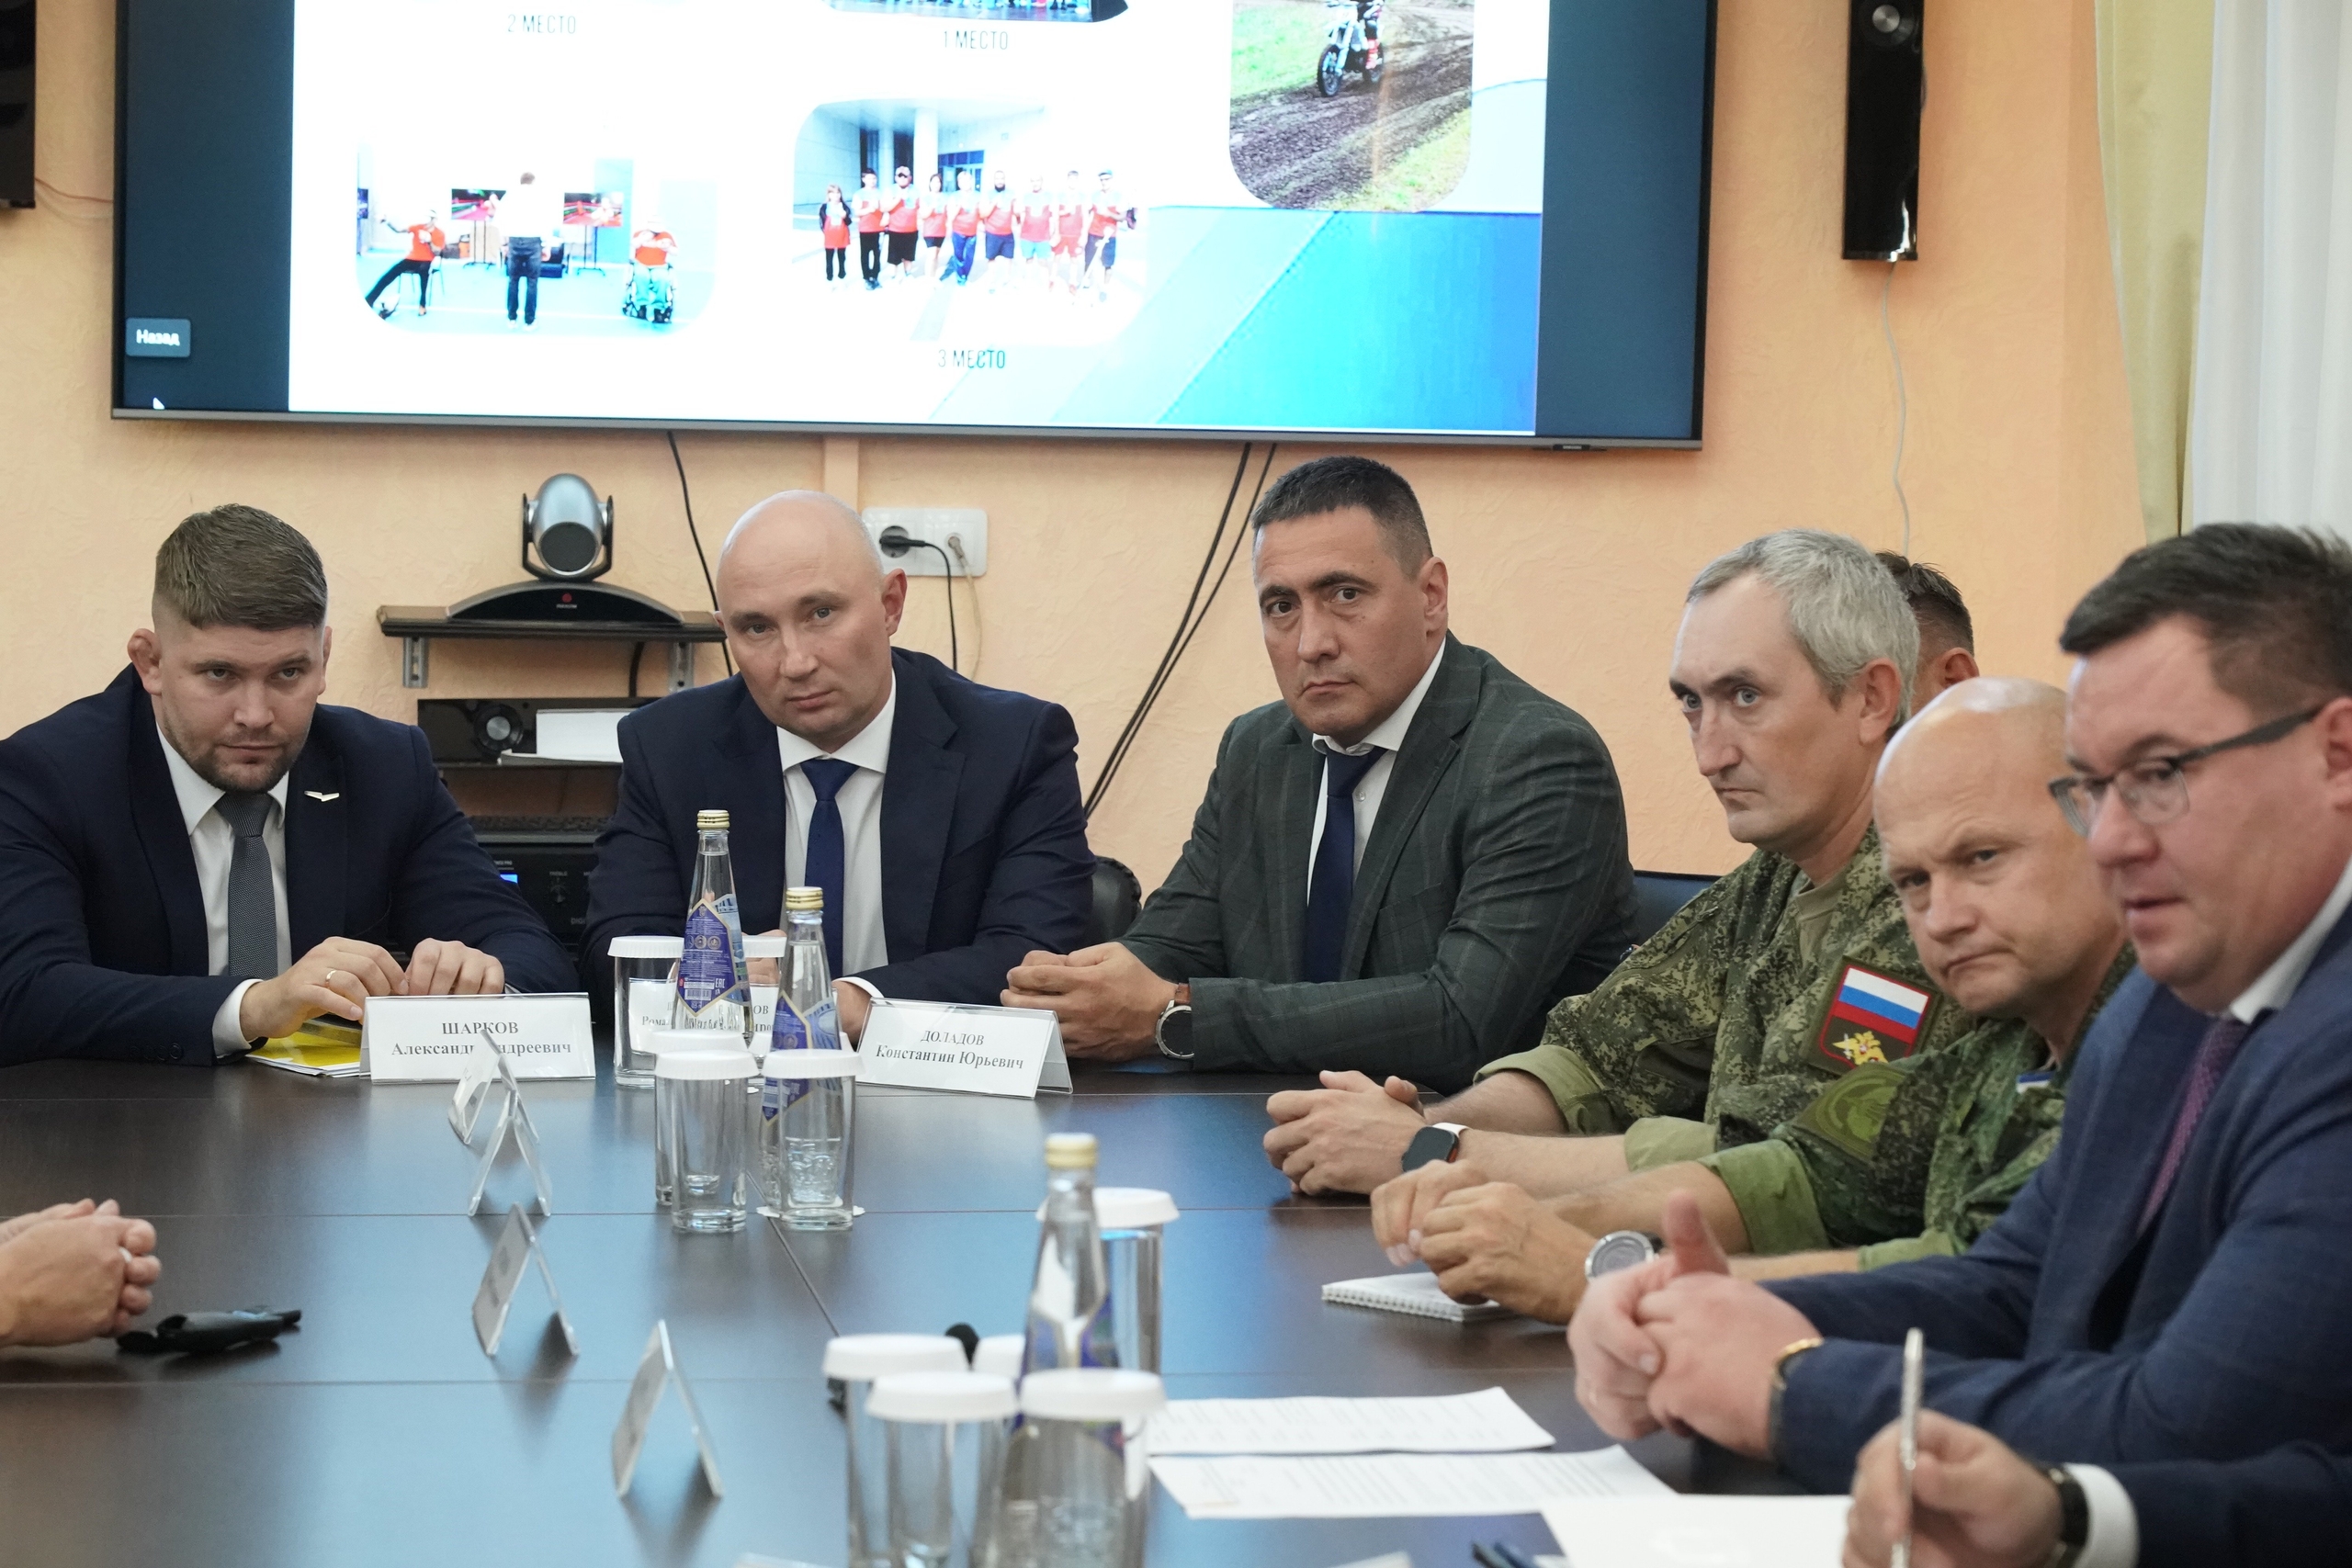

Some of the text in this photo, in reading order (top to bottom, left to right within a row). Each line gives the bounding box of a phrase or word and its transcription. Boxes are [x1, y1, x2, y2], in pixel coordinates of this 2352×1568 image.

[507, 14, 576, 35] 2 МЕСТО
[956, 30, 1009, 51] МЕСТО
[136, 329, 181, 347] Назад
[938, 349, 1006, 369] 3 МЕСТО
[442, 1021, 520, 1035] ШАРКОВ
[920, 1030, 986, 1046] ДОЛАДОВ
[501, 1043, 571, 1057] ндреевич
[876, 1044, 1024, 1069] Константин Юрьевич
